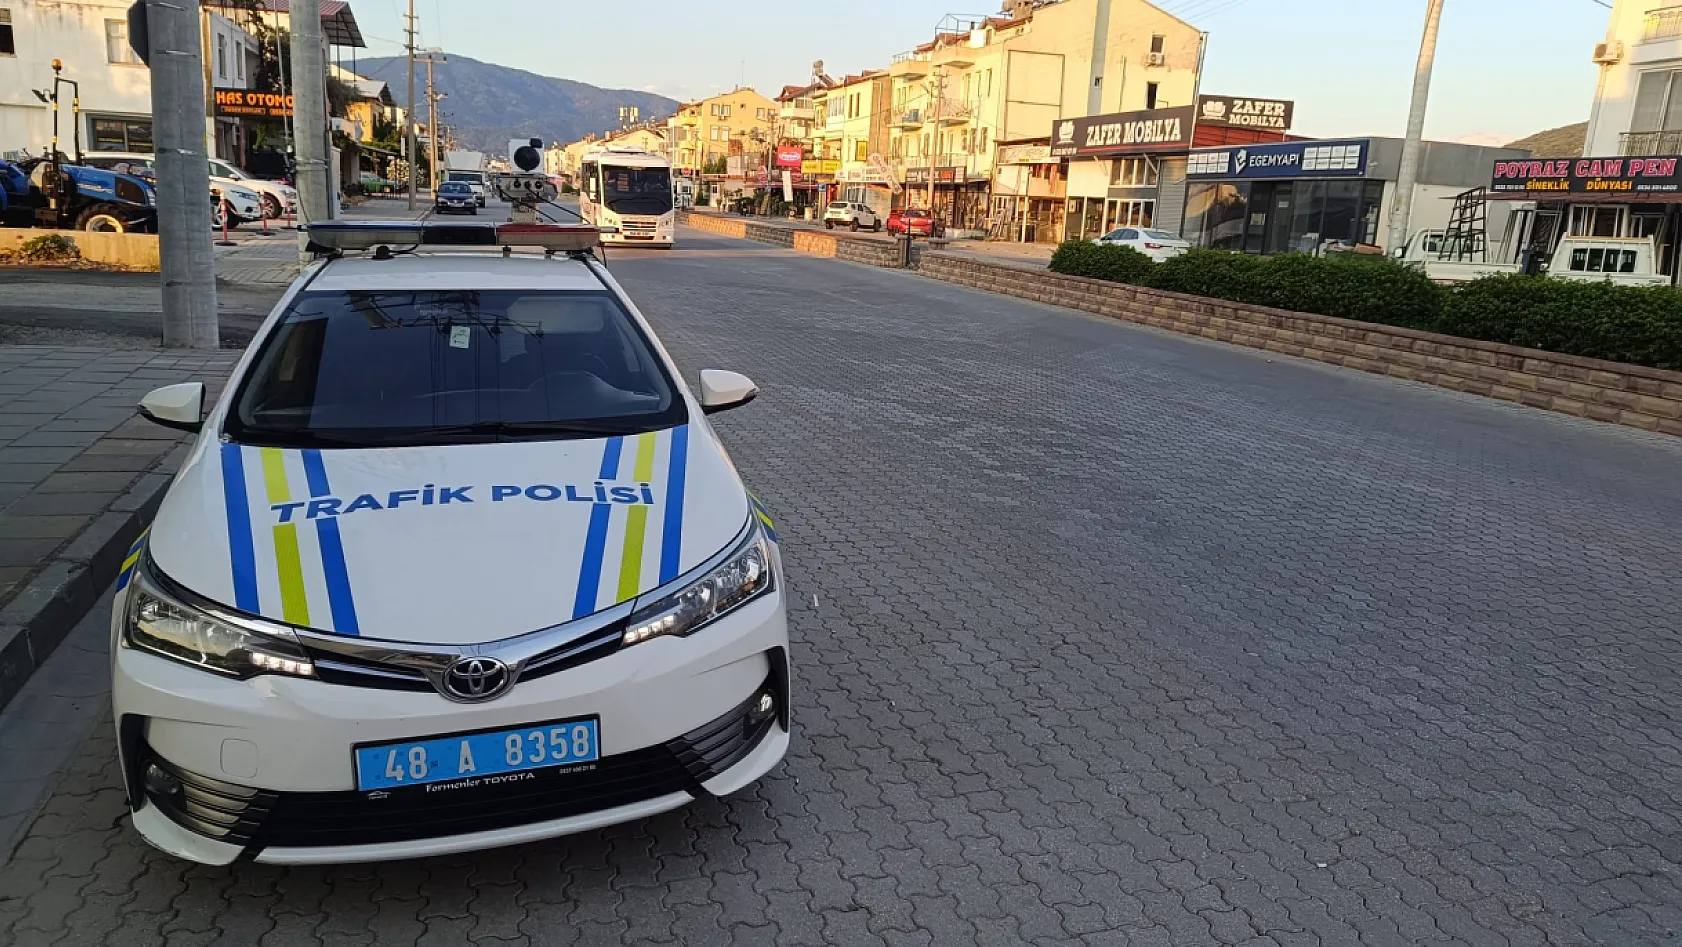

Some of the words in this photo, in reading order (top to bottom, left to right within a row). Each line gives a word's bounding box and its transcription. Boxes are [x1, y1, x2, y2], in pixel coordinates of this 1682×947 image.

[216, 91, 243, 105] HAS
[1232, 100, 1285, 117] ZAFER
[1085, 123, 1122, 146] ZAFER
[1249, 153, 1300, 168] EGEMYAPI
[1494, 161, 1570, 178] POYRAZ
[1575, 159, 1623, 178] CAM
[1627, 158, 1677, 177] PEN
[386, 746, 428, 781] 48
[458, 740, 476, 774] A
[505, 725, 590, 766] 8358
[482, 772, 536, 785] TOYOTA
